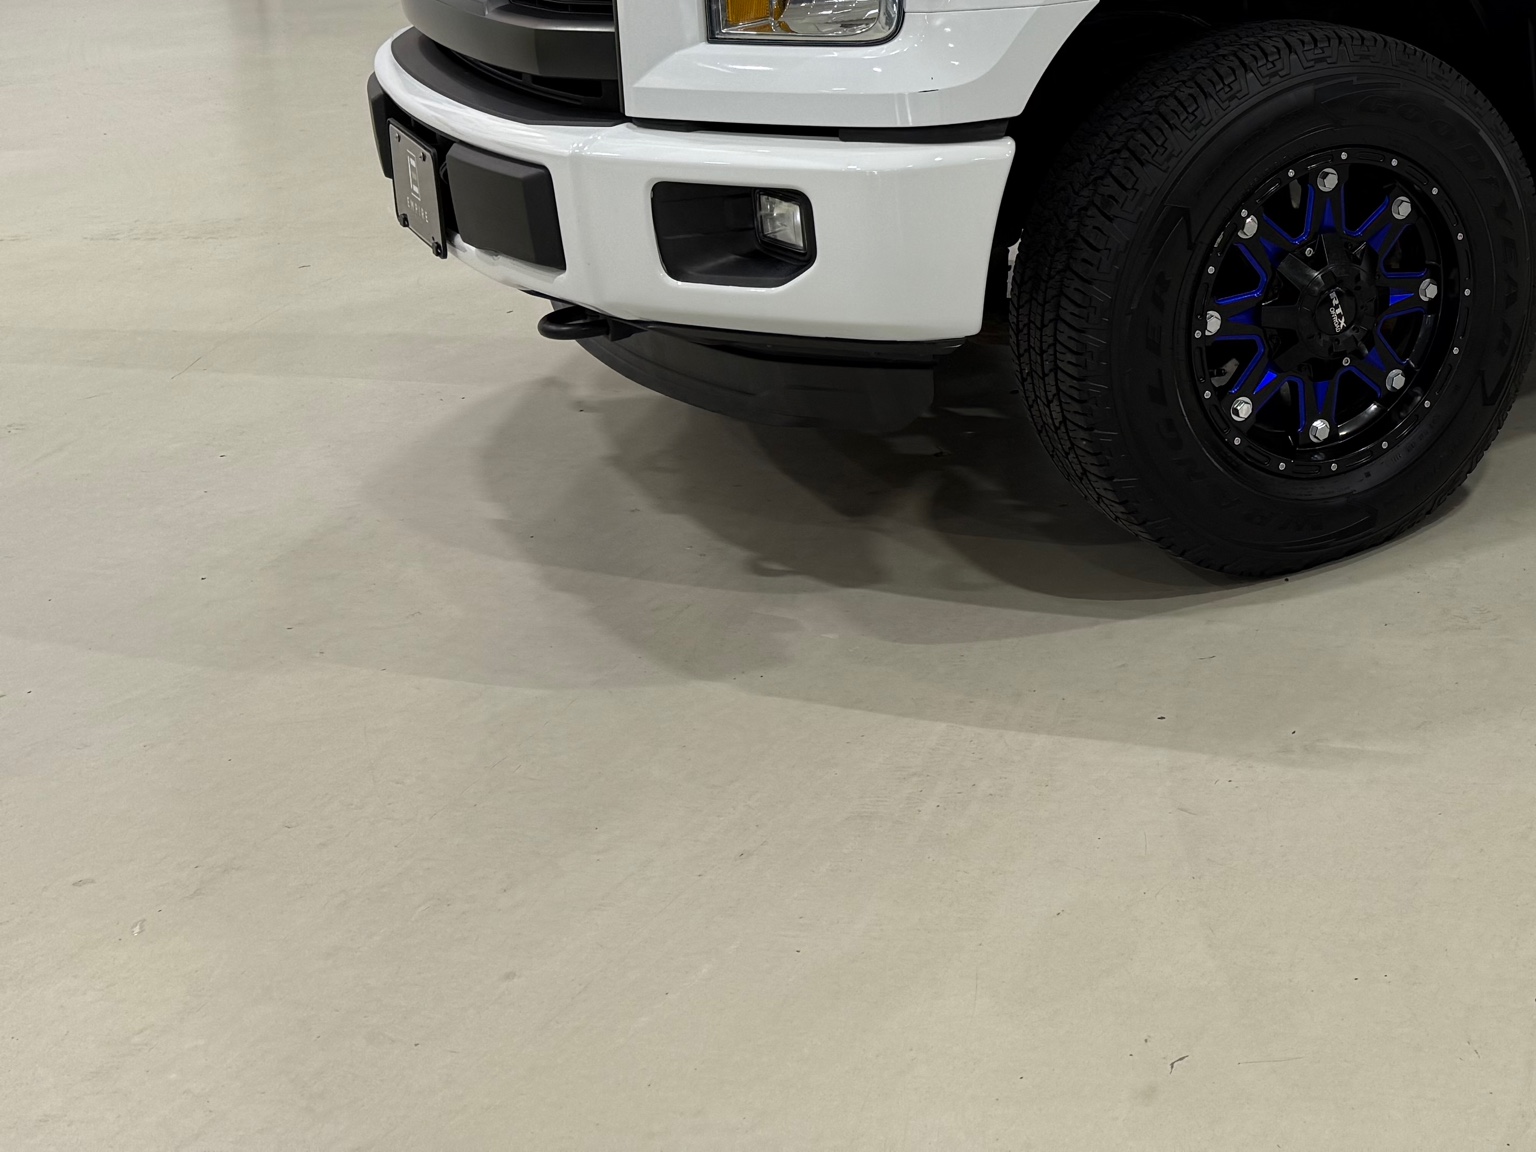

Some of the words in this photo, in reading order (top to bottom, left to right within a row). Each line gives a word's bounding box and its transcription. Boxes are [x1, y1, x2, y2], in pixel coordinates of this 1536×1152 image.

[406, 196, 429, 223] EMPIRE
[1357, 94, 1519, 357] GOODYEAR
[1329, 291, 1347, 330] RTX
